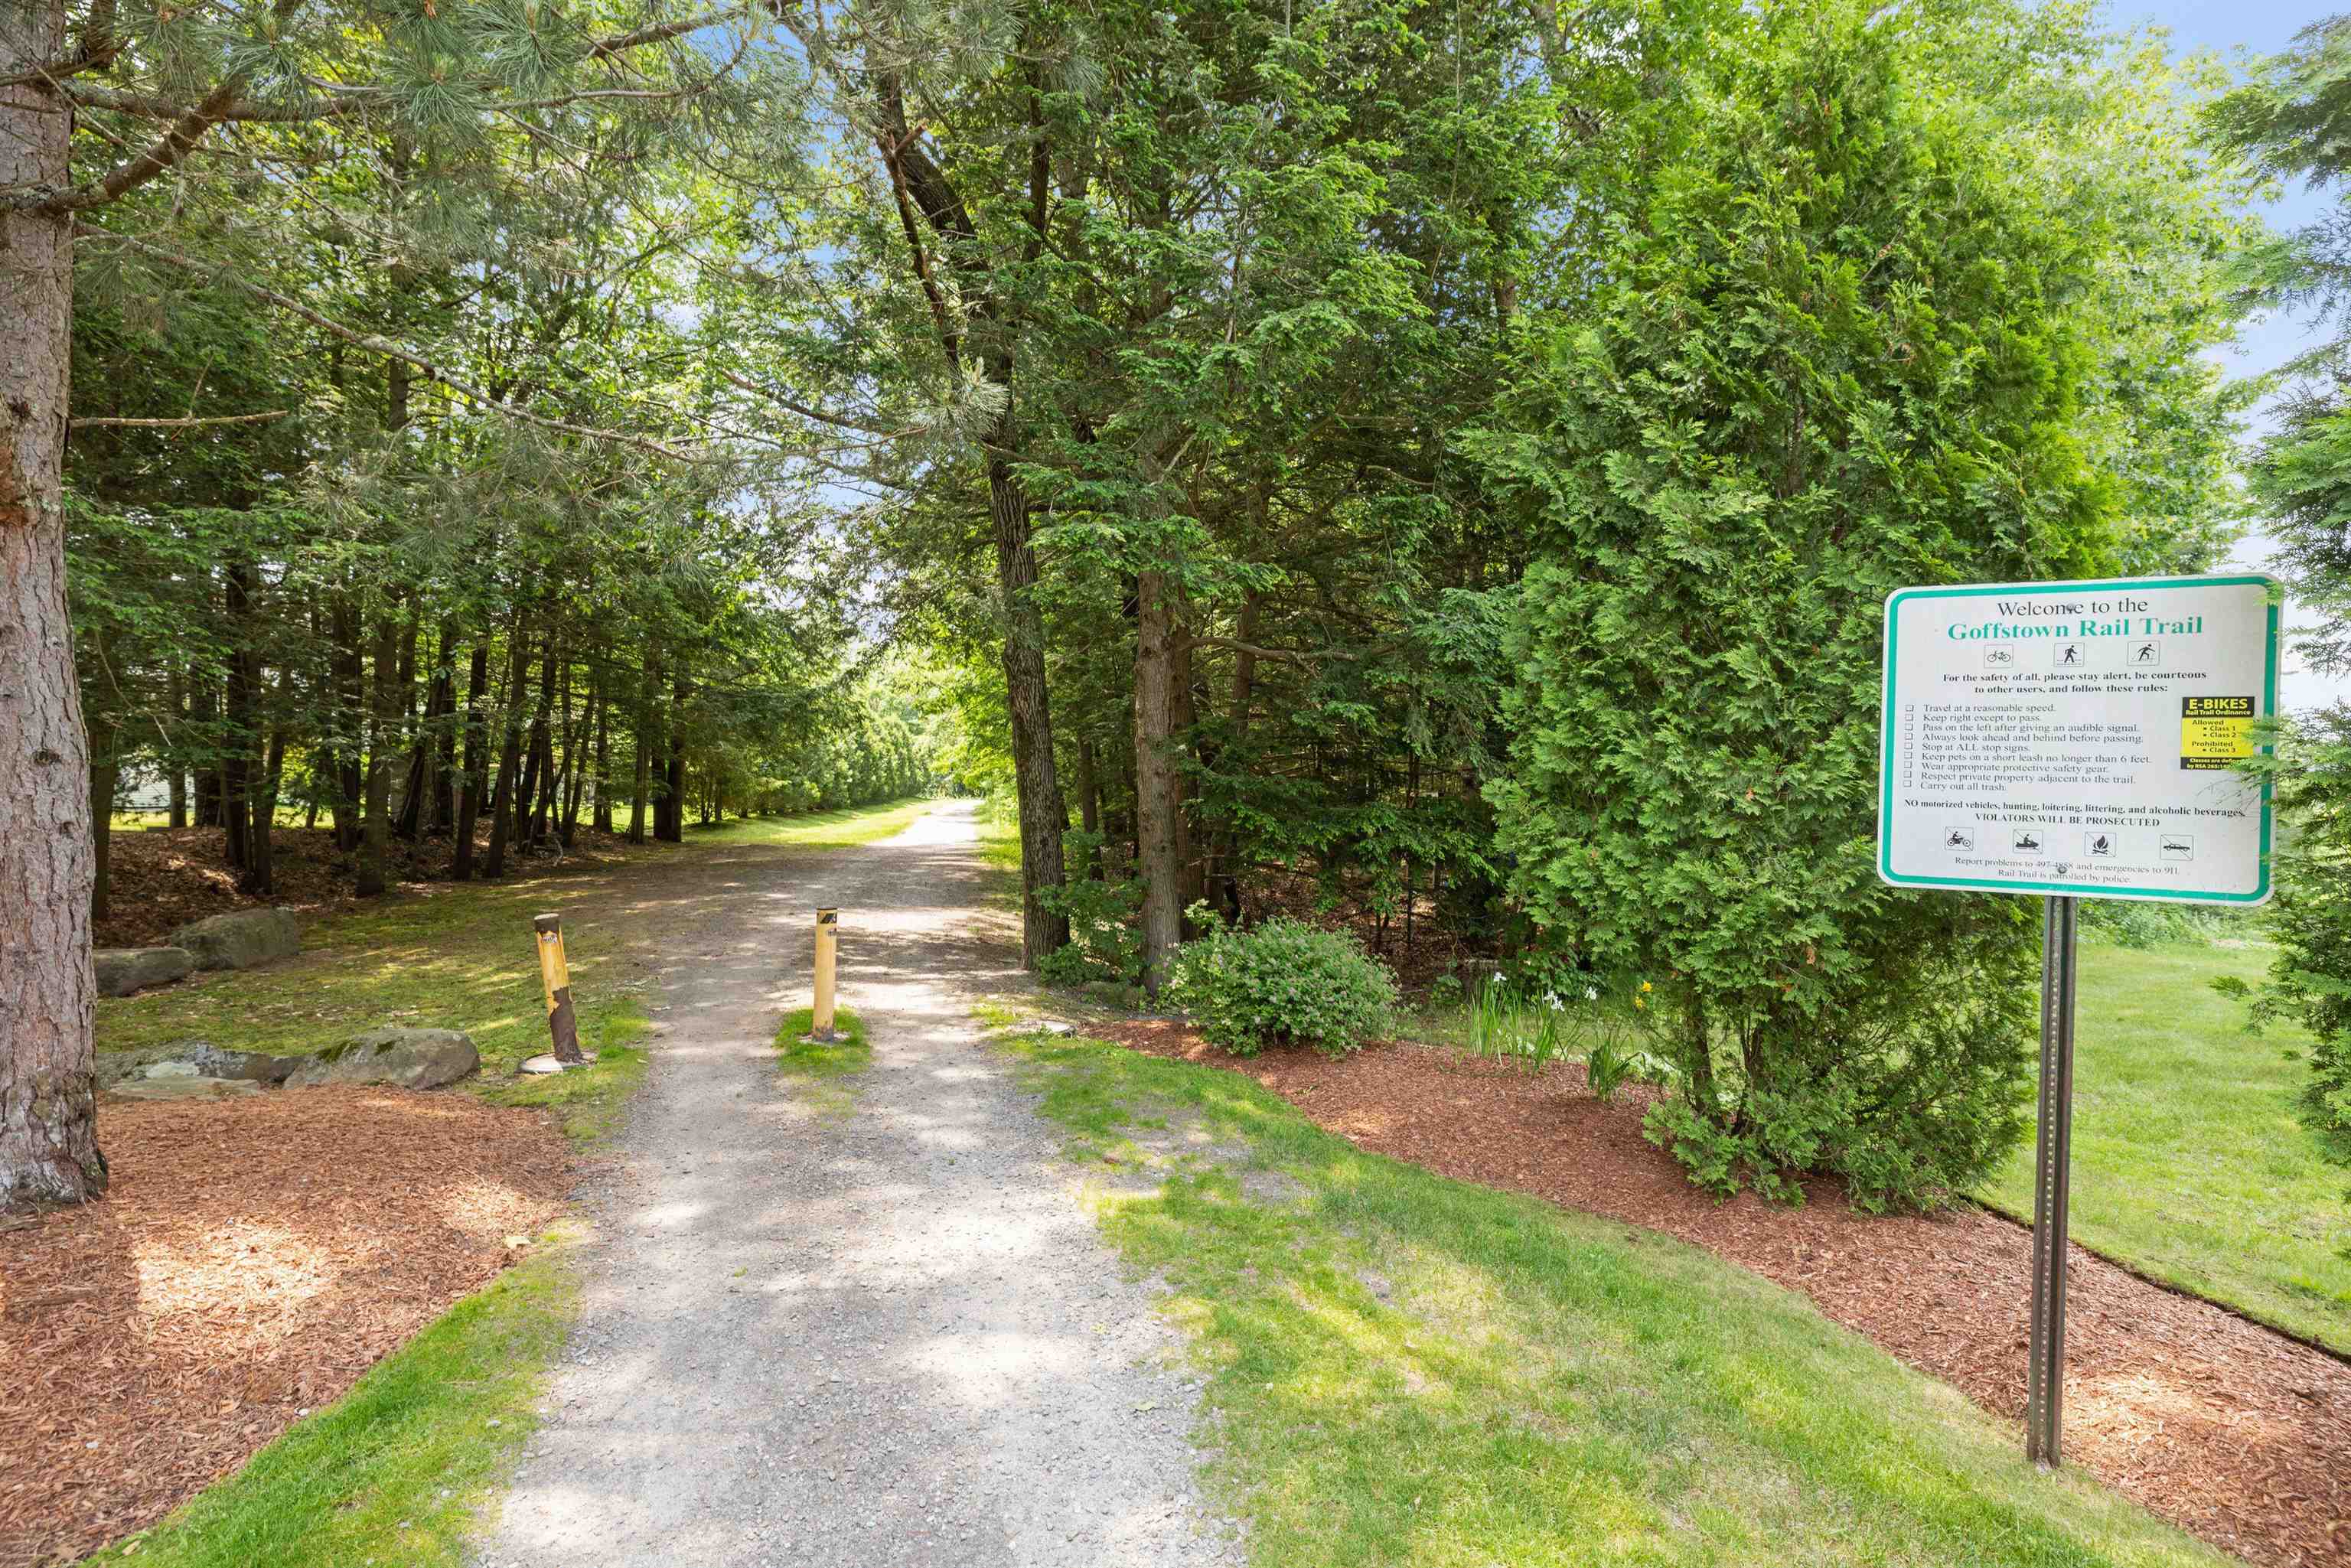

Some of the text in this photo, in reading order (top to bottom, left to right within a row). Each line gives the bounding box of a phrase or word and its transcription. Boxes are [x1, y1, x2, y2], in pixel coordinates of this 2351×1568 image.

[1997, 598, 2147, 616] Welcome to the
[1948, 615, 2203, 640] Goffstown Rail Trail
[1963, 673, 1978, 682] the
[1981, 673, 2007, 683] safety
[2013, 673, 2023, 681] of
[2044, 673, 2075, 683] please
[2079, 673, 2098, 683] stay
[2135, 672, 2147, 680] be
[2150, 672, 2206, 680] courteous
[1974, 685, 1984, 693] to
[1987, 685, 2013, 693] other
[2049, 685, 2067, 693] and
[2072, 685, 2102, 693] follow
[2106, 684, 2134, 693] these
[2137, 684, 2167, 693] rules:
[1923, 703, 1951, 712] Travel
[1974, 703, 2022, 712] reasonable
[2190, 698, 2248, 710] E-BIKES
[1923, 715, 1946, 724] Keep
[1950, 715, 1971, 723] right
[1974, 716, 2004, 724] except
[1923, 723, 1942, 732] Pass
[2020, 725, 2050, 734] giving
[2068, 724, 2104, 732] audible
[1922, 733, 1956, 742] Always
[2033, 734, 2066, 742] behind
[2069, 734, 2100, 742] before
[1922, 744, 1942, 752] Stop
[1982, 745, 2000, 753] stop
[1922, 753, 1945, 761] Keep
[1948, 754, 1967, 762] pets
[1992, 753, 2015, 761] short
[2020, 754, 2043, 762] leash
[2062, 755, 2092, 764] longer
[2095, 755, 2116, 763] than
[1922, 762, 1944, 771] Wear
[1948, 764, 2000, 773] appropriate
[2003, 764, 2050, 773] protective
[2053, 764, 2082, 774] safety
[1921, 771, 1956, 781] Respect
[1959, 773, 1991, 782] private
[1994, 774, 2034, 784] property
[2038, 774, 2078, 784] adjacent
[2095, 775, 2110, 784] the
[1920, 782, 1946, 791] Carry
[1905, 799, 1919, 807] NO
[1921, 800, 1963, 809] motorized
[1965, 800, 2000, 810] vehicles,
[2004, 802, 2040, 812] hunting,
[2128, 805, 2146, 813] and
[2149, 806, 2192, 815] alcoholic
[1975, 813, 2160, 826] VIOLATORS WILL BE PROSECUTED
[1955, 856, 1983, 867] Report
[1984, 859, 2022, 869] problems
[2076, 862, 2092, 870] and
[2095, 863, 2149, 875] emergencies
[1998, 869, 2015, 877] Rail
[2019, 869, 2036, 879] Trail
[2049, 872, 2087, 882] patrolled
[2103, 875, 2131, 885] police.
